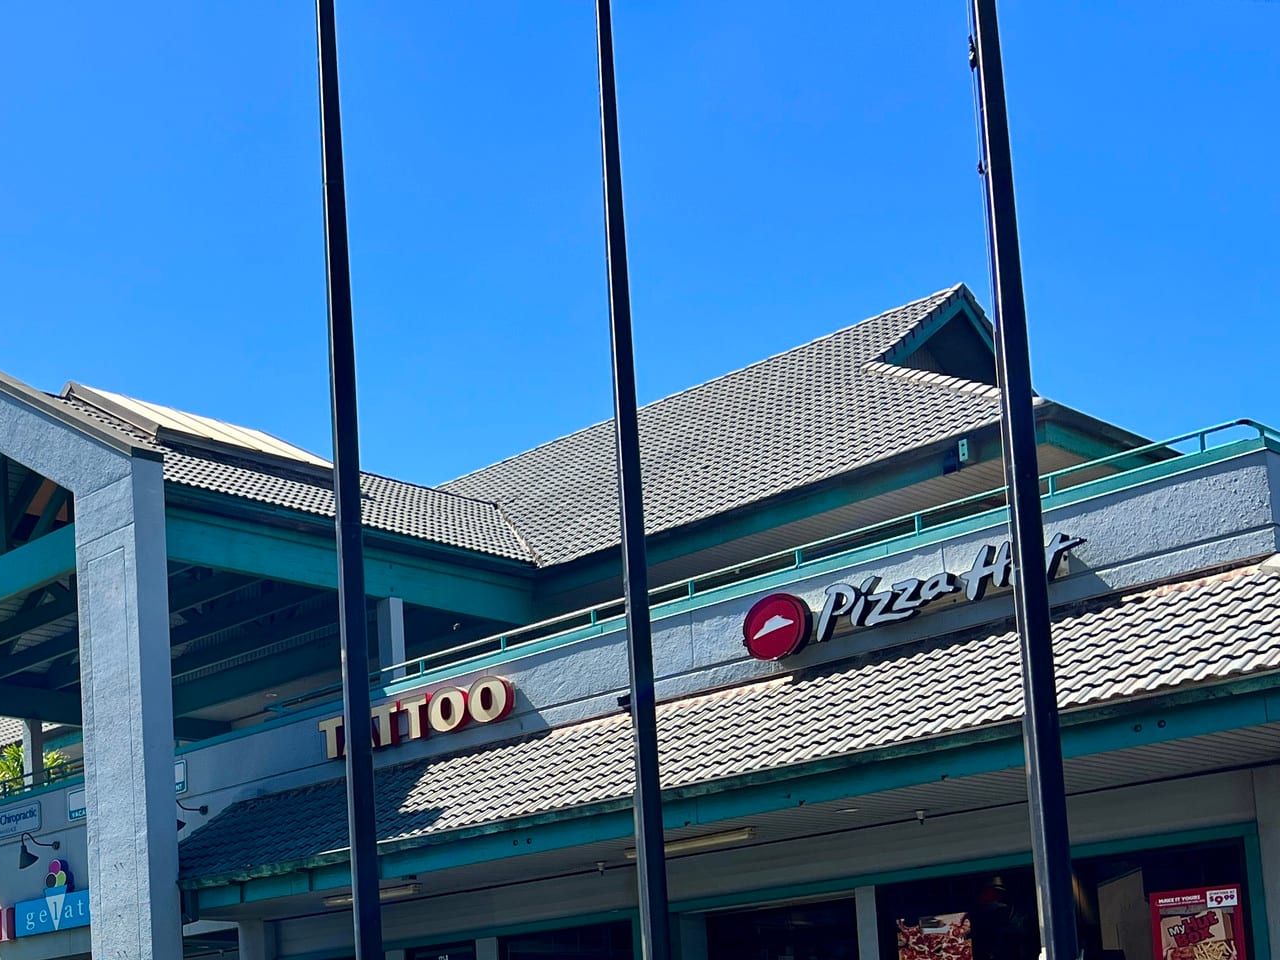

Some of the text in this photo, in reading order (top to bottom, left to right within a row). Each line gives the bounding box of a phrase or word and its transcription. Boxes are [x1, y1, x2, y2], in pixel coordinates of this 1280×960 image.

[817, 533, 1087, 642] Pizza Ht
[318, 674, 513, 759] TTTOO
[0, 807, 37, 826] Chiropractic
[26, 899, 86, 931] gelat
[1168, 911, 1219, 936] My Hut
[1174, 927, 1215, 947] BOX
